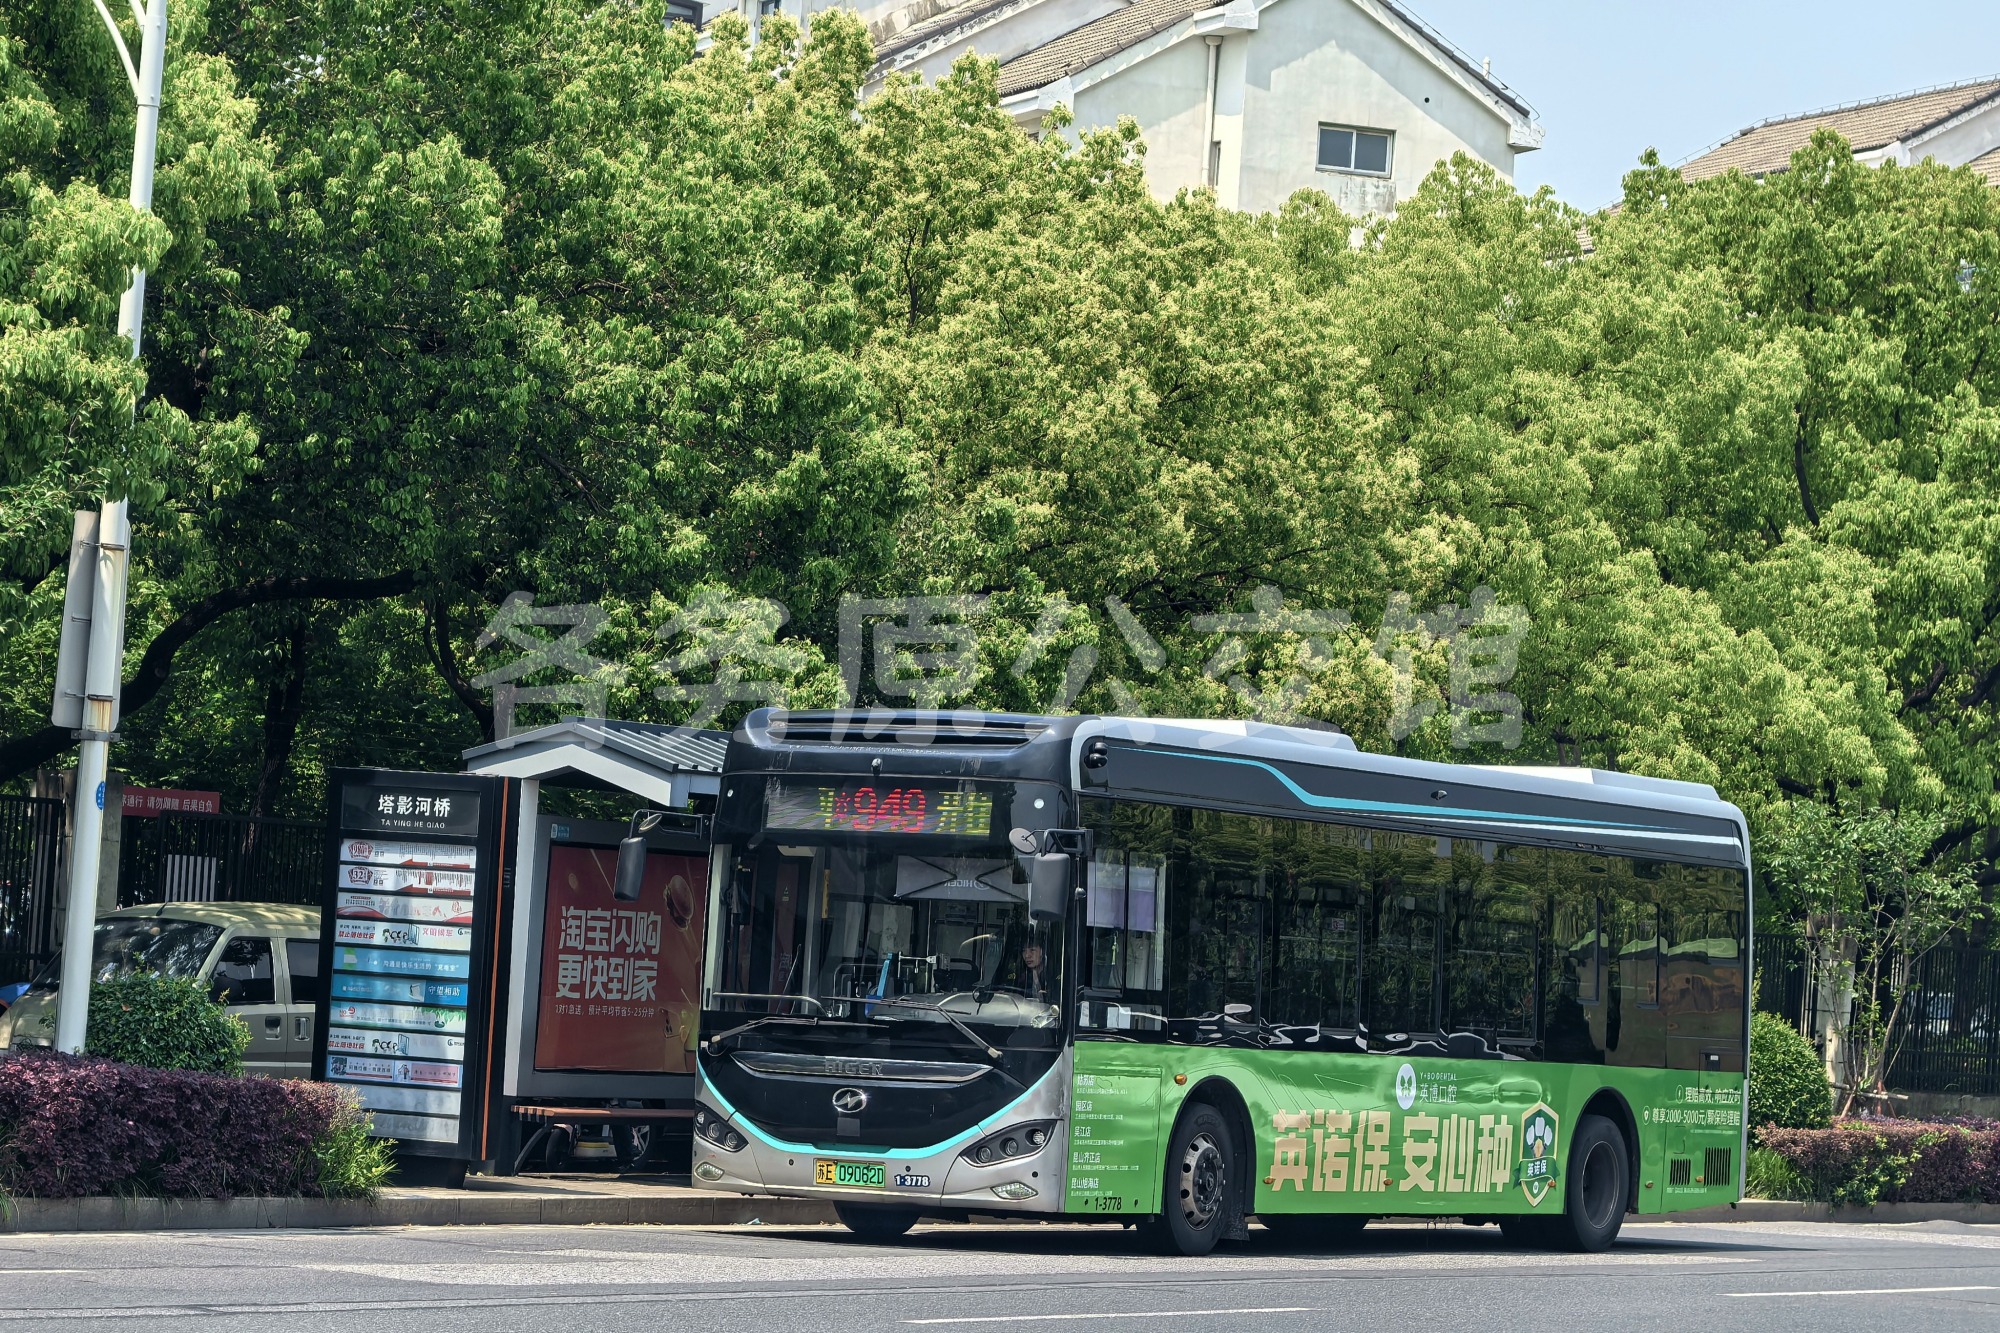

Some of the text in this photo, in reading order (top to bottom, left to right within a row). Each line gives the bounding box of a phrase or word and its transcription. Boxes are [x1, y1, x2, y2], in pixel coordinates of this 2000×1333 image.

[182, 799, 213, 813] 后果自负
[378, 794, 451, 818] 塔影河桥
[853, 787, 927, 832] 949
[558, 905, 662, 955] 淘宝闪购
[556, 954, 659, 1002] 更快到家
[825, 1059, 884, 1076] HIGER
[1419, 1083, 1458, 1103] 英博口腔
[1652, 1107, 1741, 1126] 尊享2000-5000元/颗保险理赔
[1074, 1126, 1091, 1137] 吴江店
[1269, 1108, 1514, 1193] 英诺保 安心种
[1527, 1159, 1547, 1177] 英诺保
[1094, 1196, 1122, 1211] 1-3778
